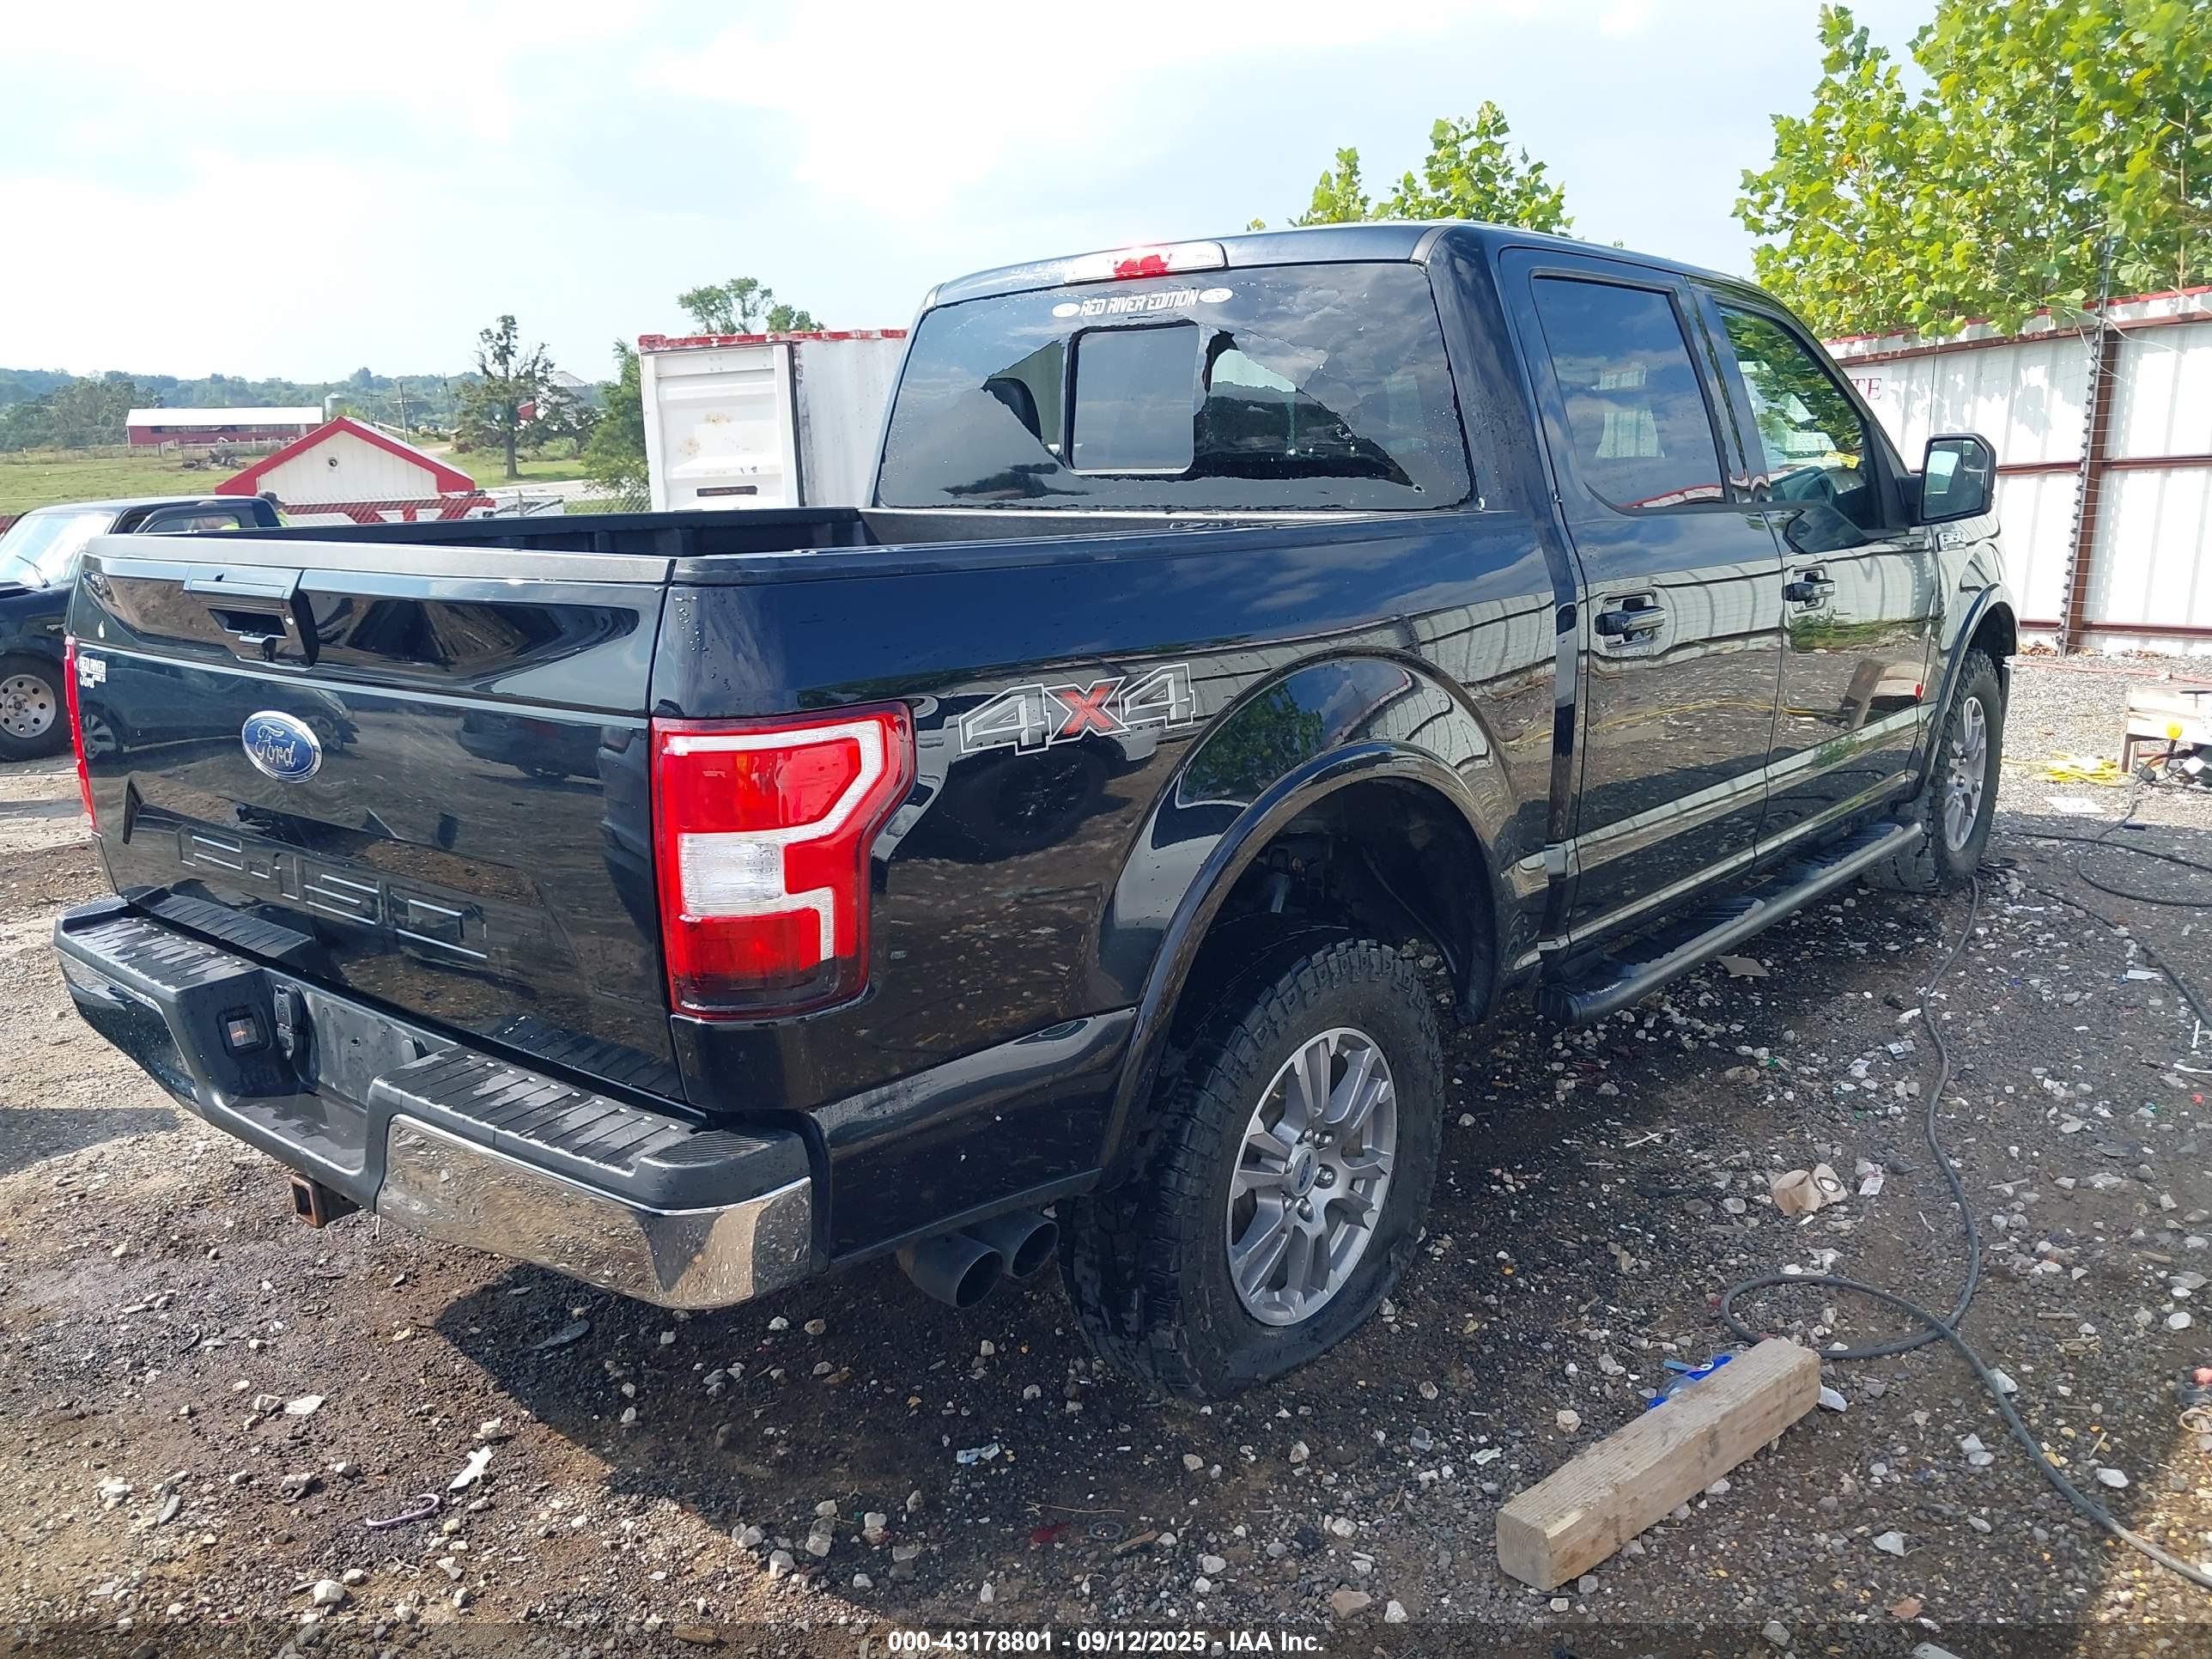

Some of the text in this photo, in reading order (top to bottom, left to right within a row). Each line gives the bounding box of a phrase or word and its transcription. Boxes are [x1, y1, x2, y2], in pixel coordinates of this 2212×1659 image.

[1079, 299, 1107, 316] RED
[1108, 295, 1146, 314] RIVER
[1147, 289, 1200, 310] EDITION
[254, 725, 297, 767] Ford
